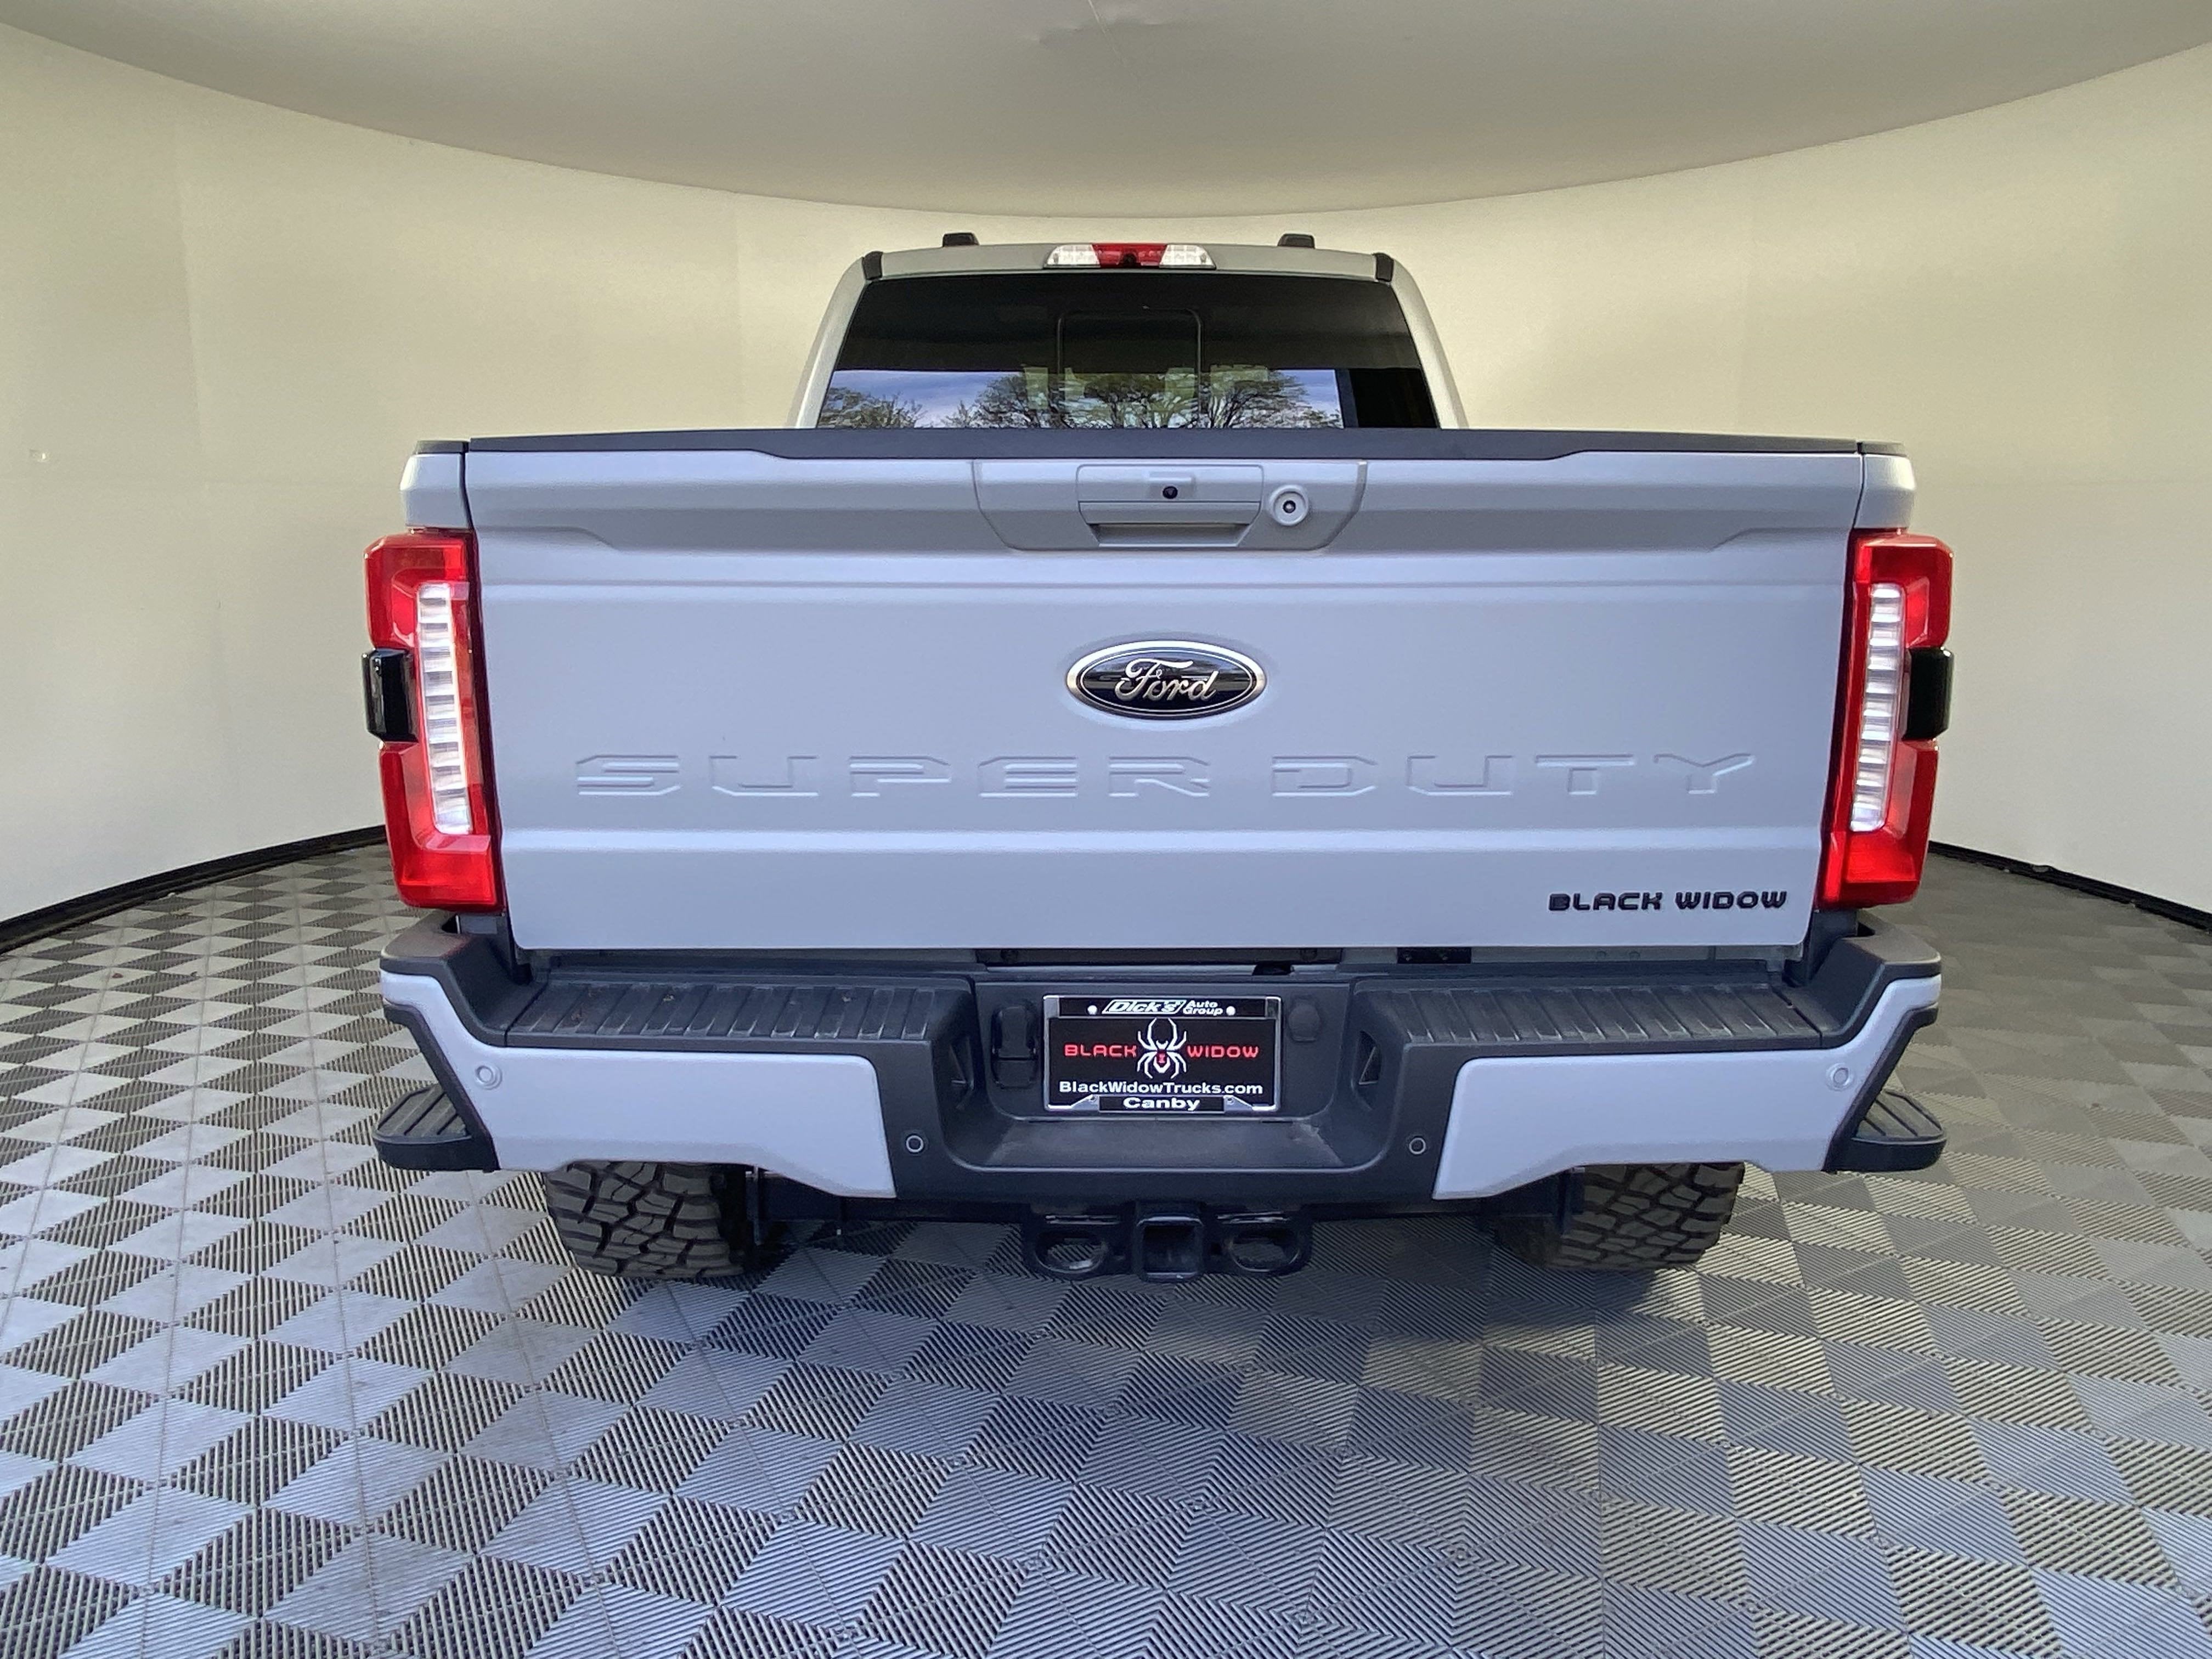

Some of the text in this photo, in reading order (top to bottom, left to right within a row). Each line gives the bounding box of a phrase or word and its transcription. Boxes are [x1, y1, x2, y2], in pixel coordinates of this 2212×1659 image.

[1115, 658, 1219, 701] Ford
[576, 754, 1754, 797] SUPER DUTY
[1549, 891, 1787, 911] BLACK WIDOW
[1183, 1007, 1223, 1016] Group
[1064, 1045, 1259, 1058] BLACK WIDOW
[1059, 1081, 1263, 1094] BlackWidowTrucks.com
[1123, 1097, 1200, 1111] Canby
